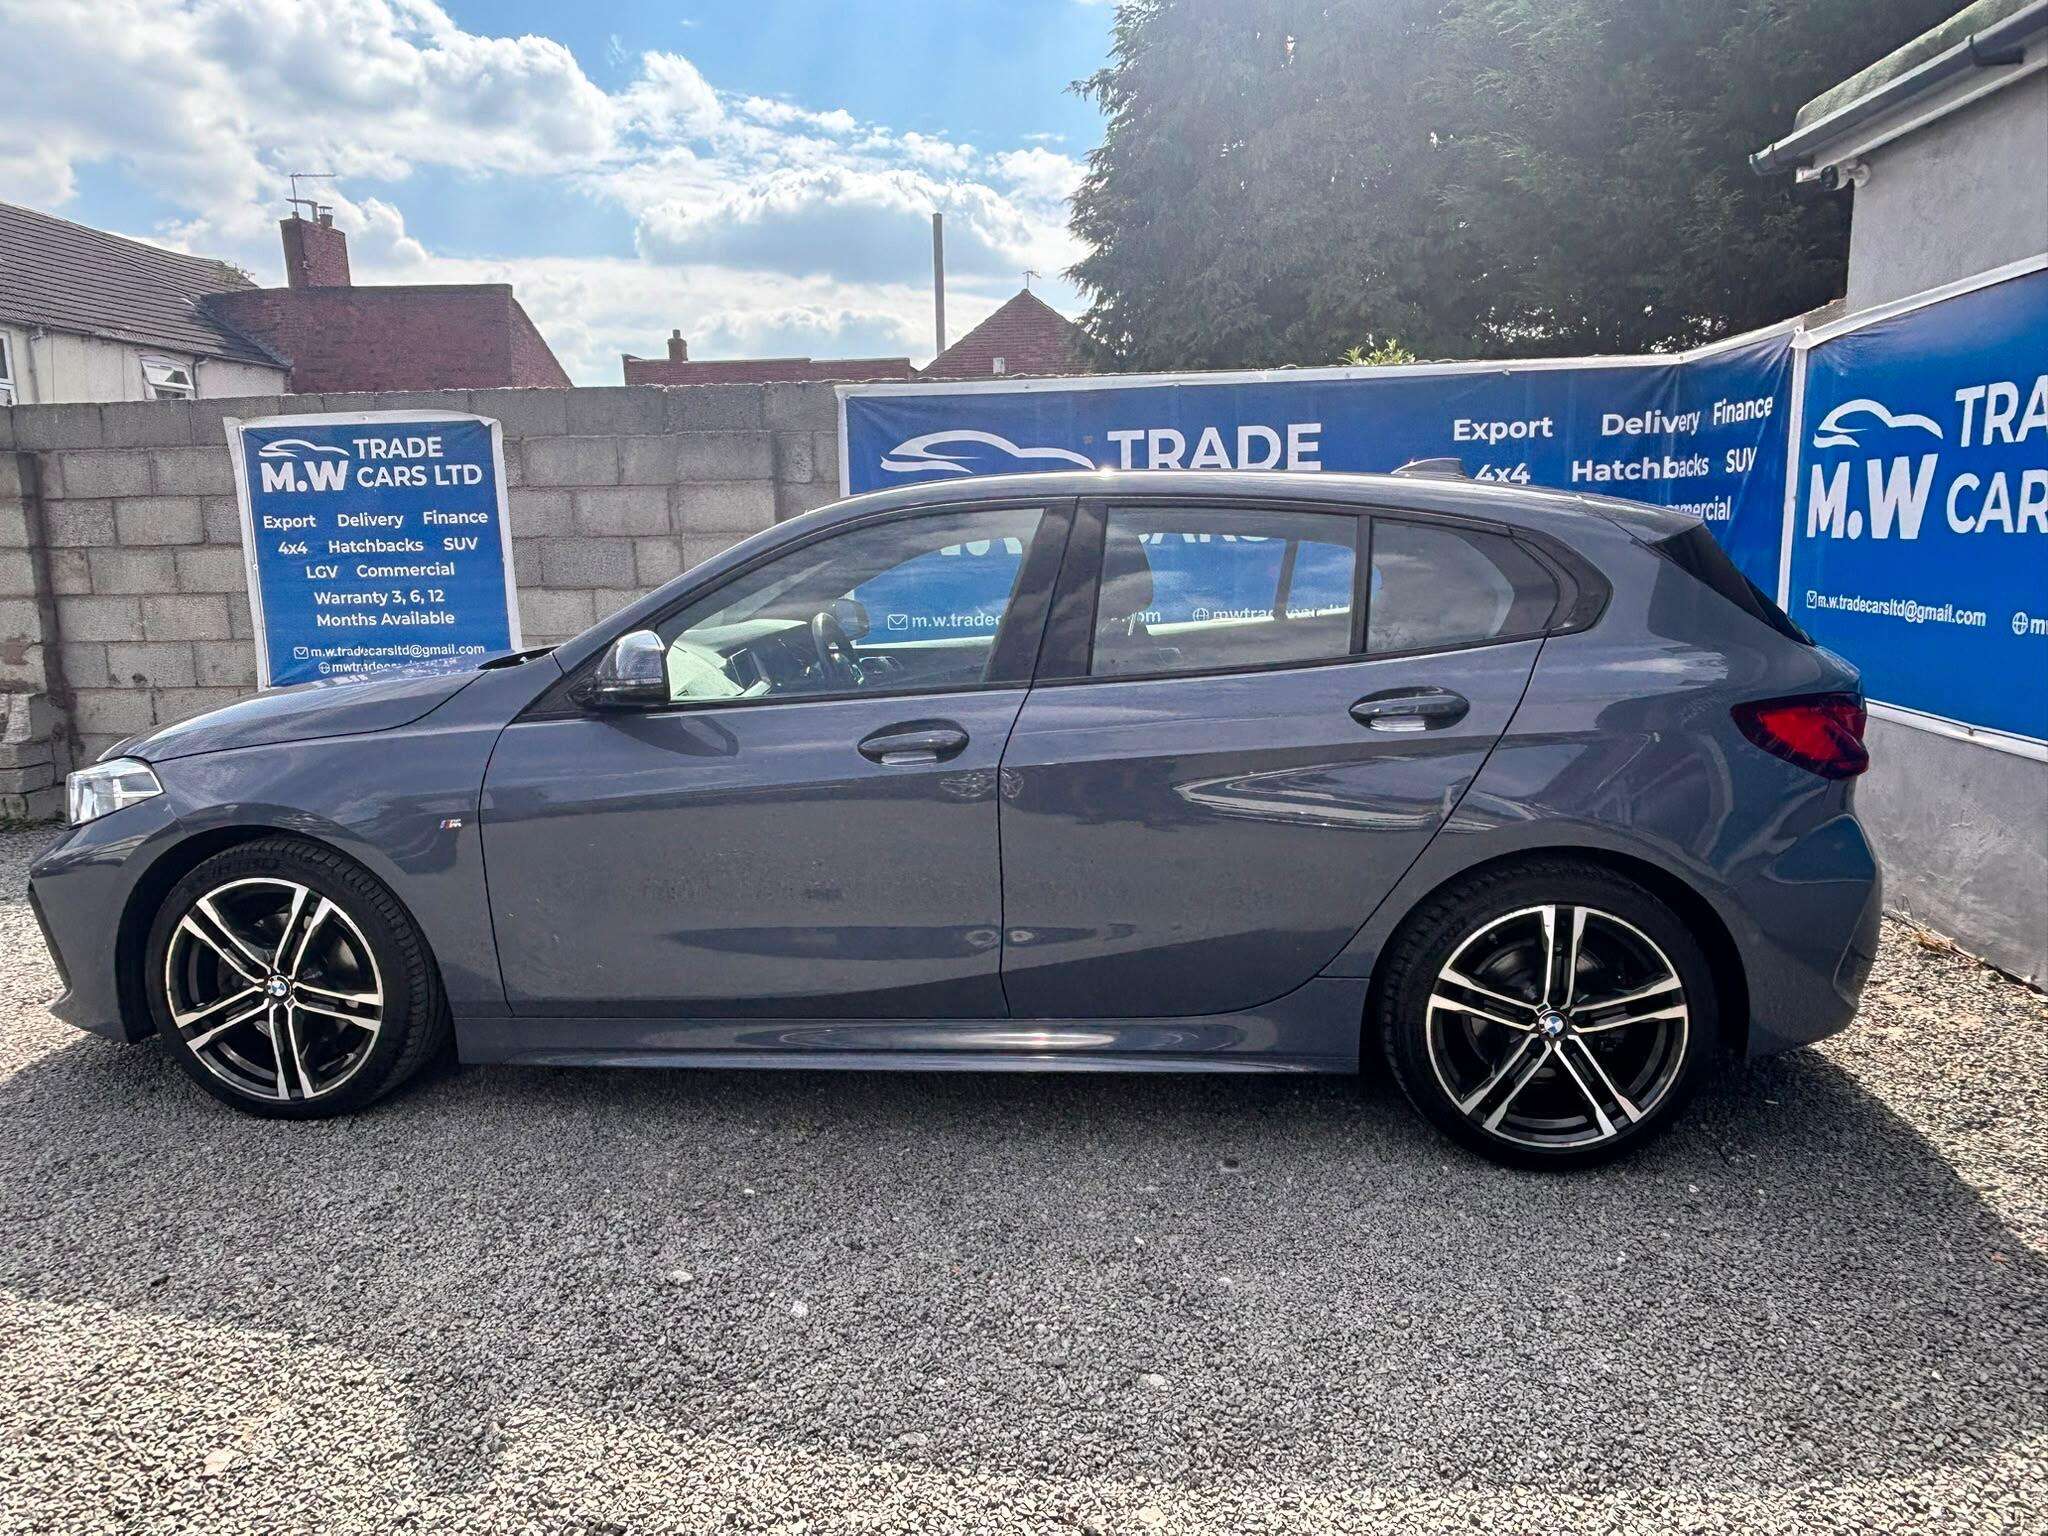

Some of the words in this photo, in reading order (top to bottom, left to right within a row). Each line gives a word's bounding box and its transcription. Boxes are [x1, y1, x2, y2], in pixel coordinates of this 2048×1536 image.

[1453, 416, 1553, 445] Export
[1601, 408, 1700, 437] Delivery
[1713, 396, 1773, 426] Finance
[352, 436, 444, 460] TRADE
[1107, 423, 1322, 471] TRADE
[258, 459, 349, 493] M.W
[356, 465, 427, 489] CARS
[434, 464, 483, 486] LTD
[1474, 462, 1531, 485] 4x4
[1572, 453, 1709, 483] Hatchbacks
[1726, 446, 1757, 474] SUV
[1806, 453, 1939, 540] M.W
[263, 514, 316, 531] Export
[337, 512, 404, 531] Delivery
[423, 510, 488, 525] Finance
[278, 541, 308, 555] 4x4
[328, 538, 424, 554] Hatchbacks
[443, 537, 478, 551] SUV
[306, 565, 338, 579] LGV
[356, 562, 455, 578] Commercial
[314, 591, 388, 607] Warranty
[391, 590, 406, 606] 3,
[410, 590, 425, 605] 6,
[428, 590, 445, 603] 12
[1818, 593, 1986, 627] m.w.tradecarsltd@gmail.com
[316, 612, 377, 627] Months
[381, 610, 455, 626] Available
